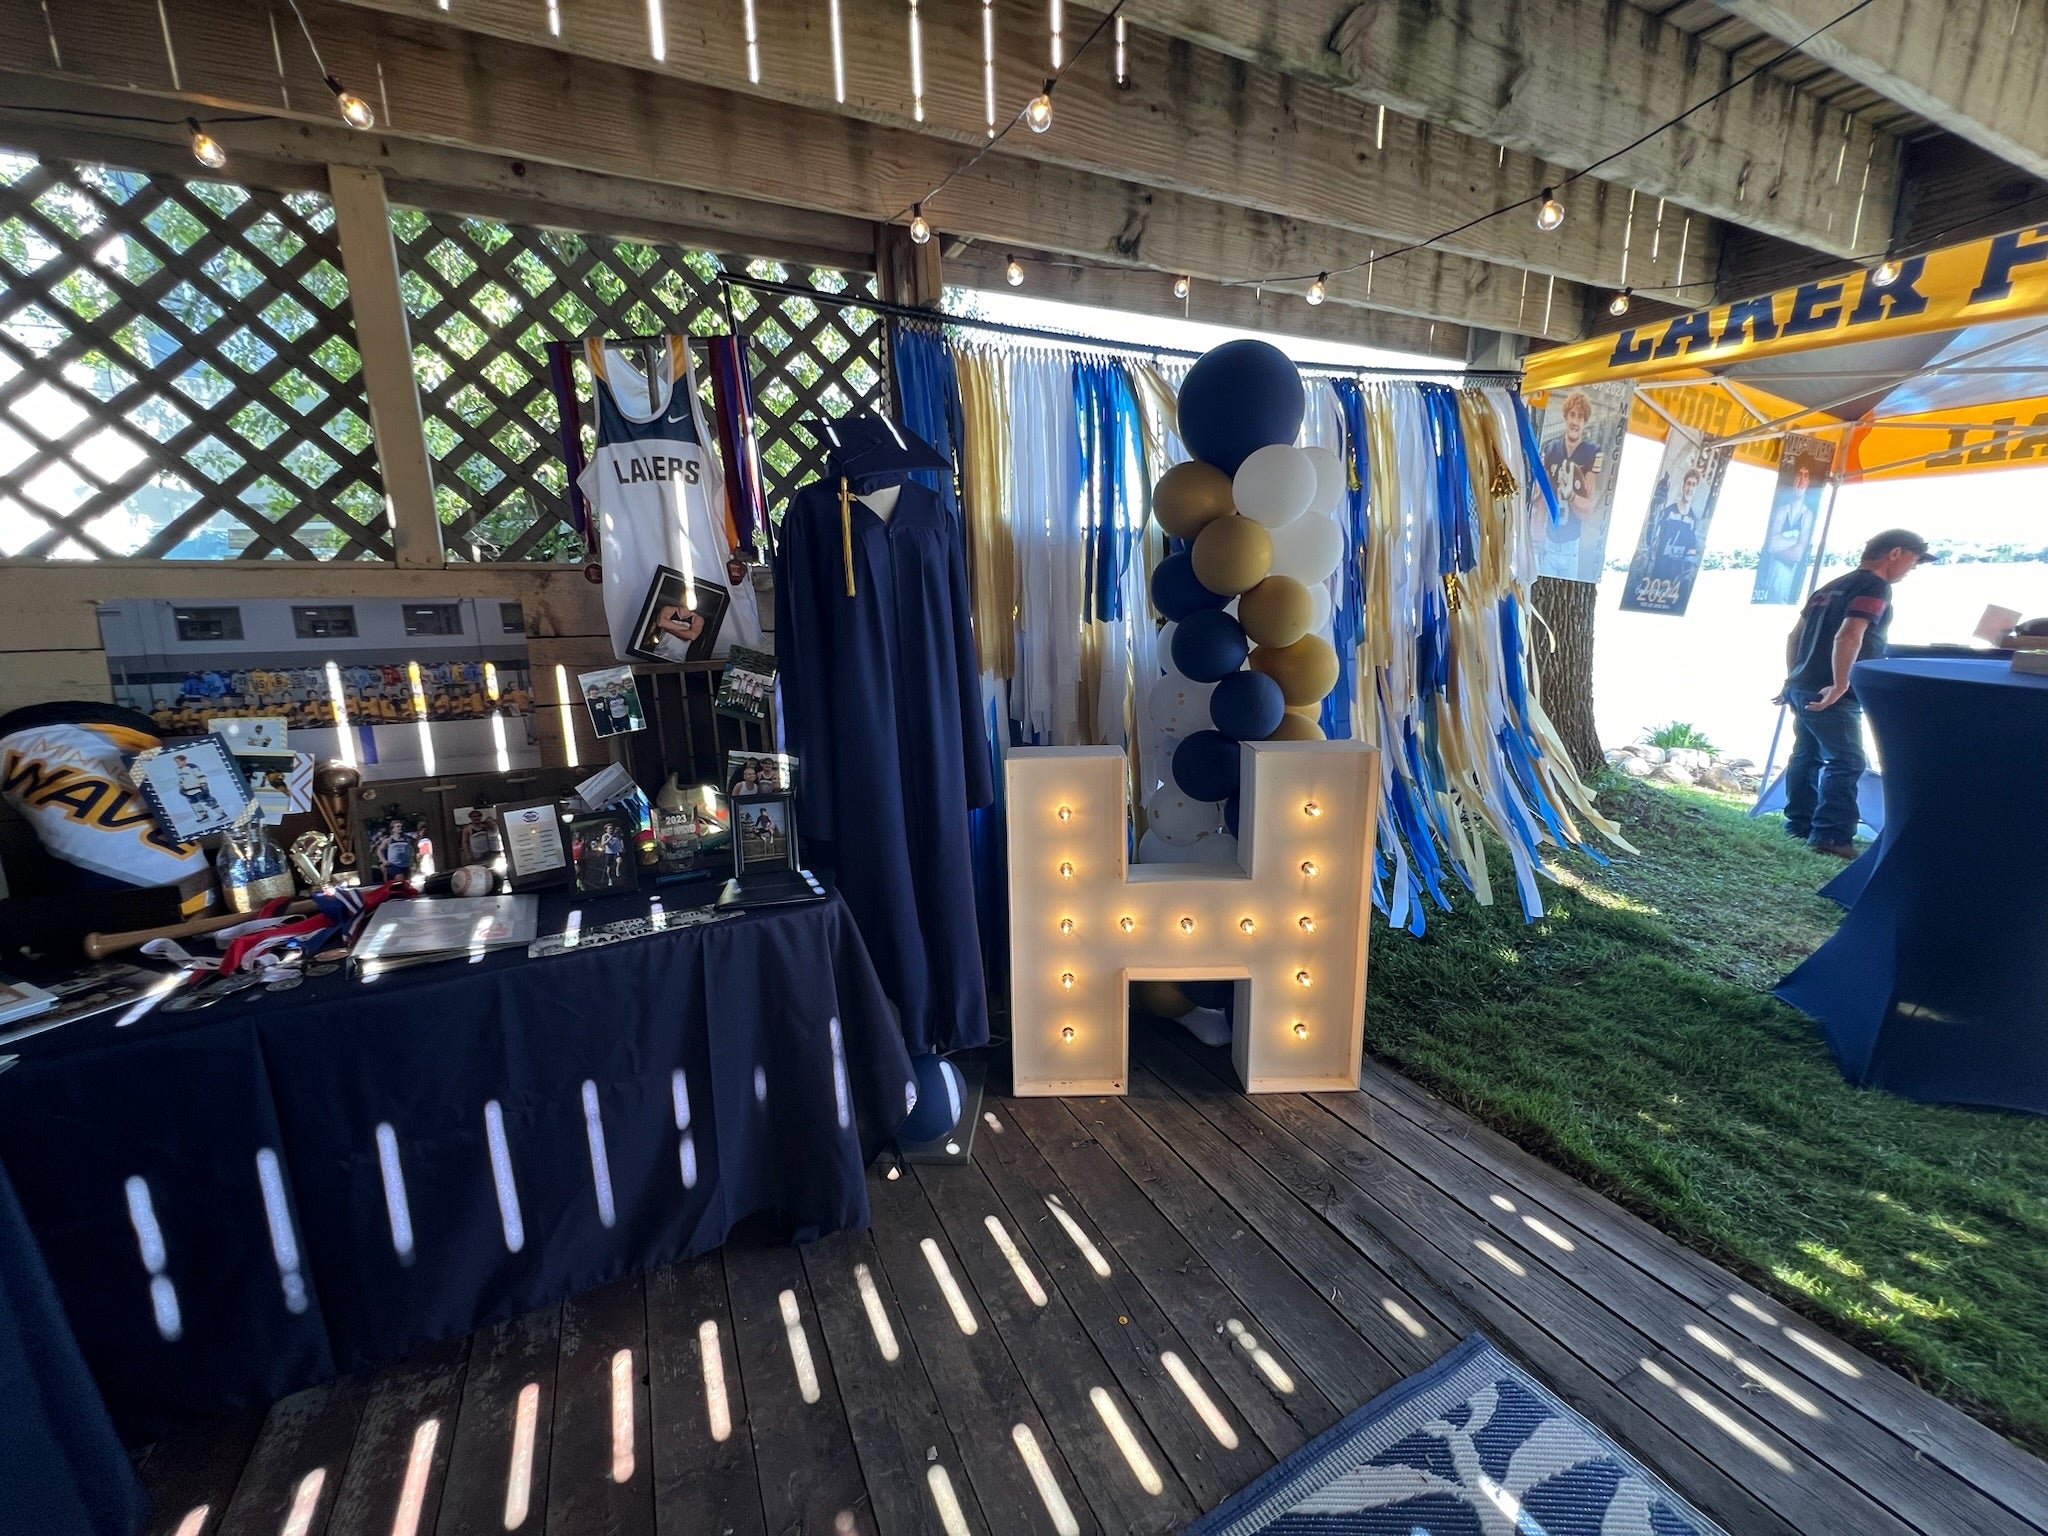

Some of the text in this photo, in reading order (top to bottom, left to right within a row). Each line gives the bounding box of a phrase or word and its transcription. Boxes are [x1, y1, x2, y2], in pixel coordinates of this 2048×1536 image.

[1609, 256, 1929, 367] LAKER
[1636, 576, 1680, 604] 2024
[665, 814, 688, 826] 2023
[1004, 740, 1380, 1098] H
